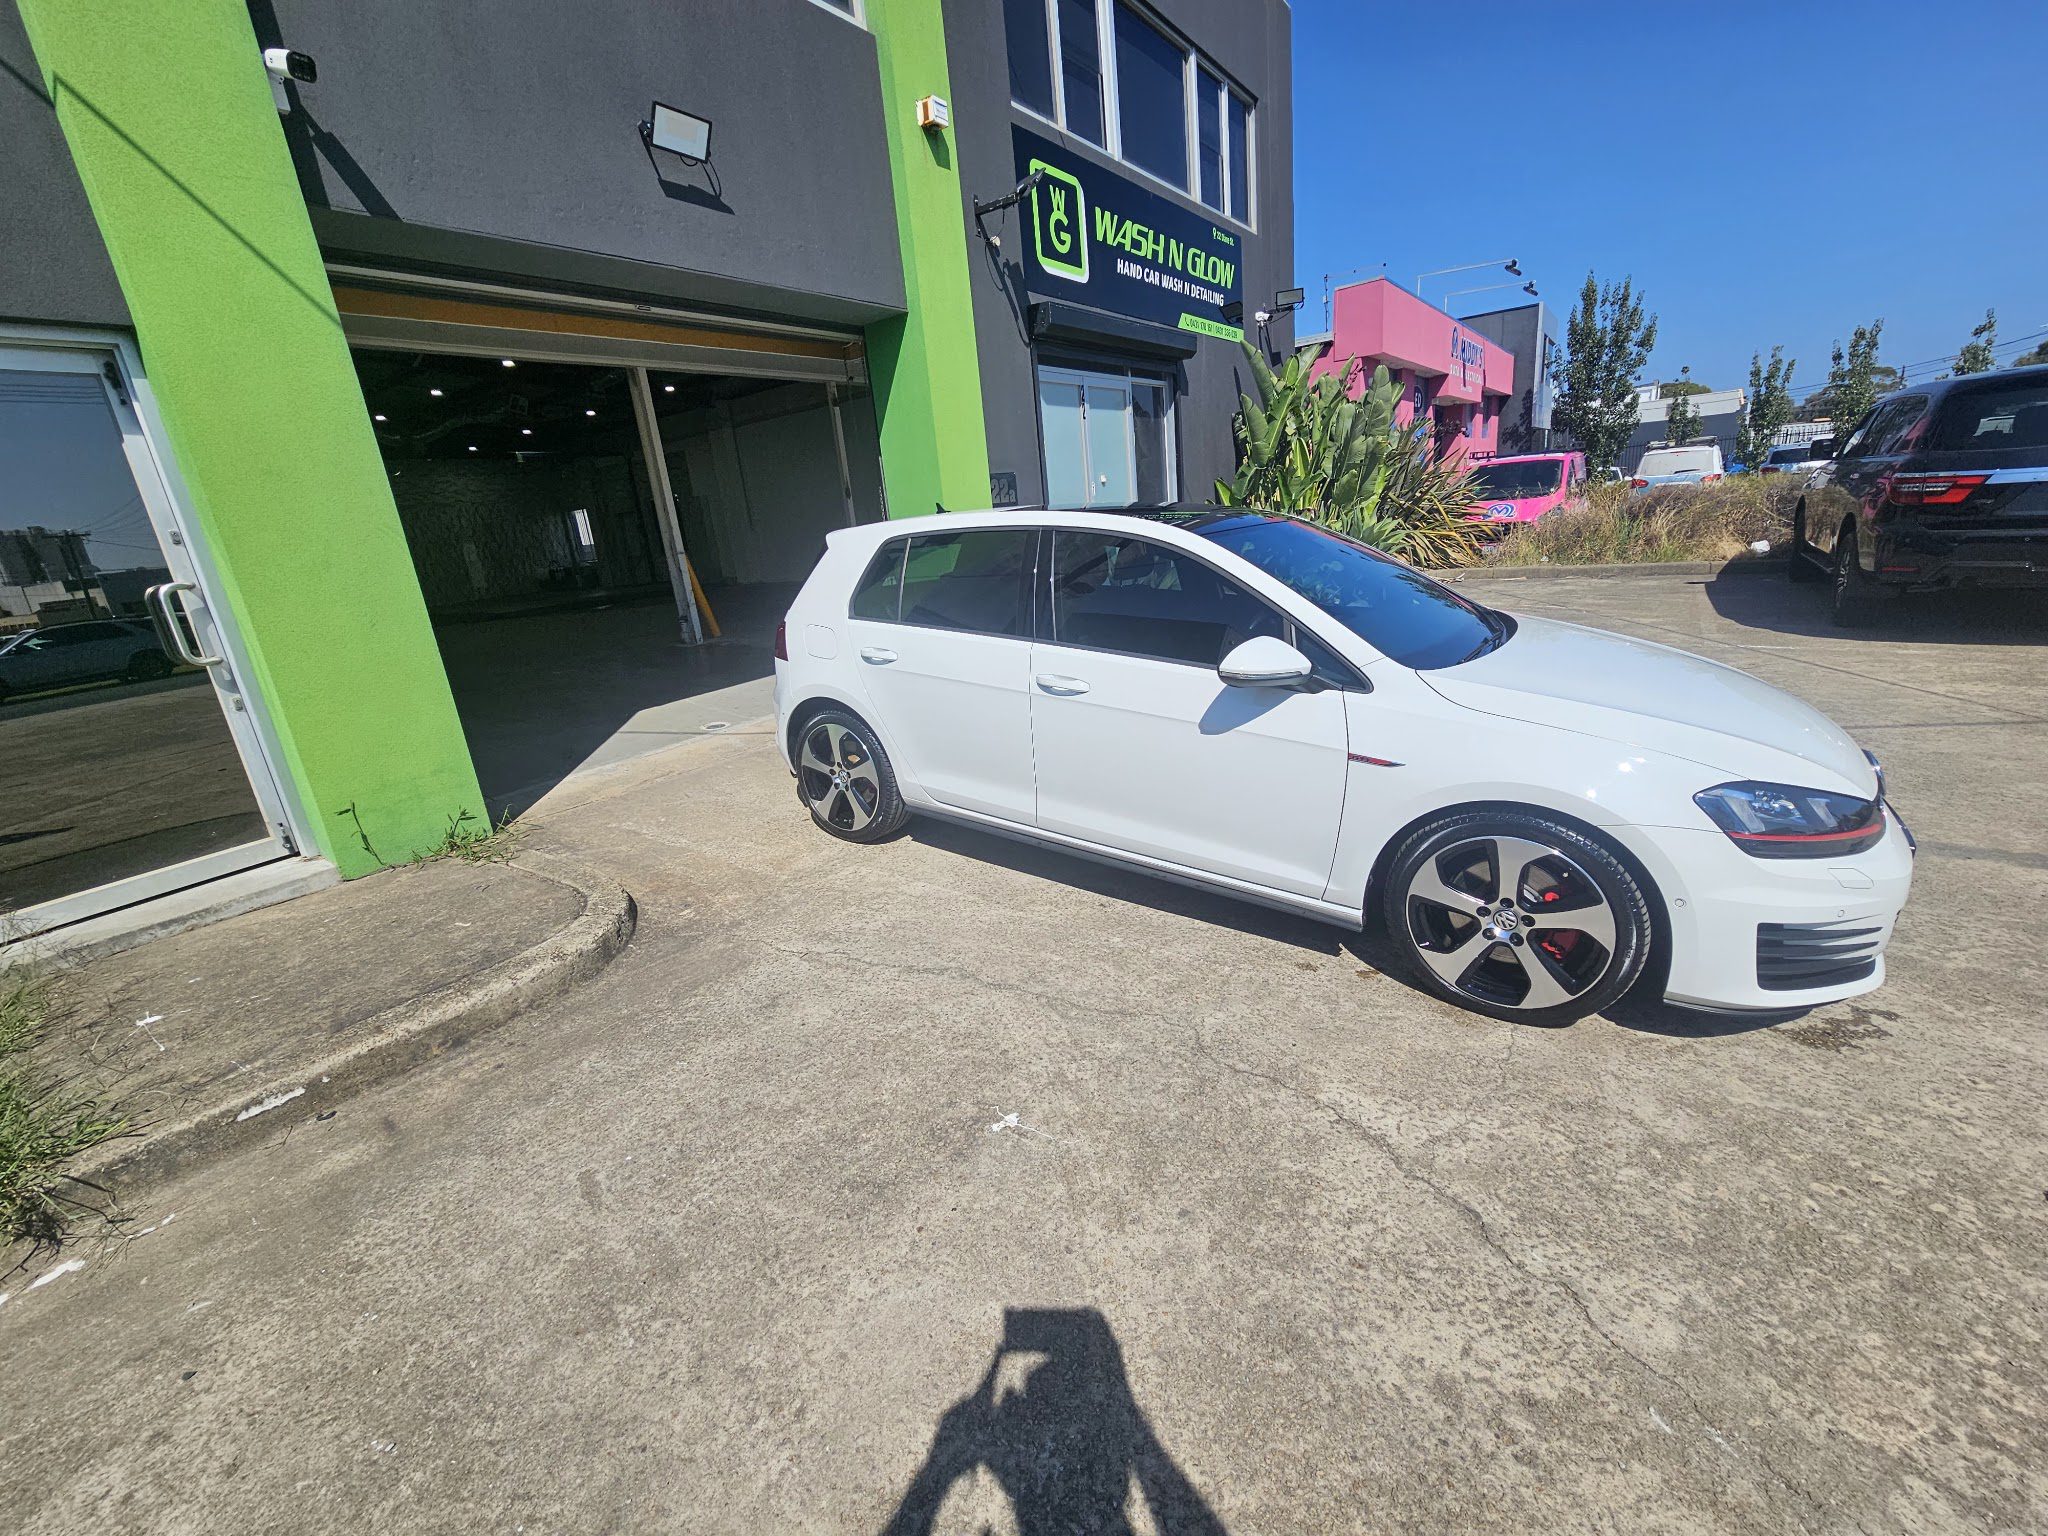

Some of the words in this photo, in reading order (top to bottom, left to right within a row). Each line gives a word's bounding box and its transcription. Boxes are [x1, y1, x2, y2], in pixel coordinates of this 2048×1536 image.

[1095, 206, 1165, 264] WASH
[1168, 238, 1184, 271] N
[1187, 247, 1235, 289] GLOW
[1117, 258, 1143, 280] HAND
[1143, 266, 1160, 286] CAR
[1161, 273, 1184, 294] WASH
[1184, 281, 1190, 296] N
[1190, 283, 1225, 307] DETAILING
[991, 478, 1016, 504] 22a
